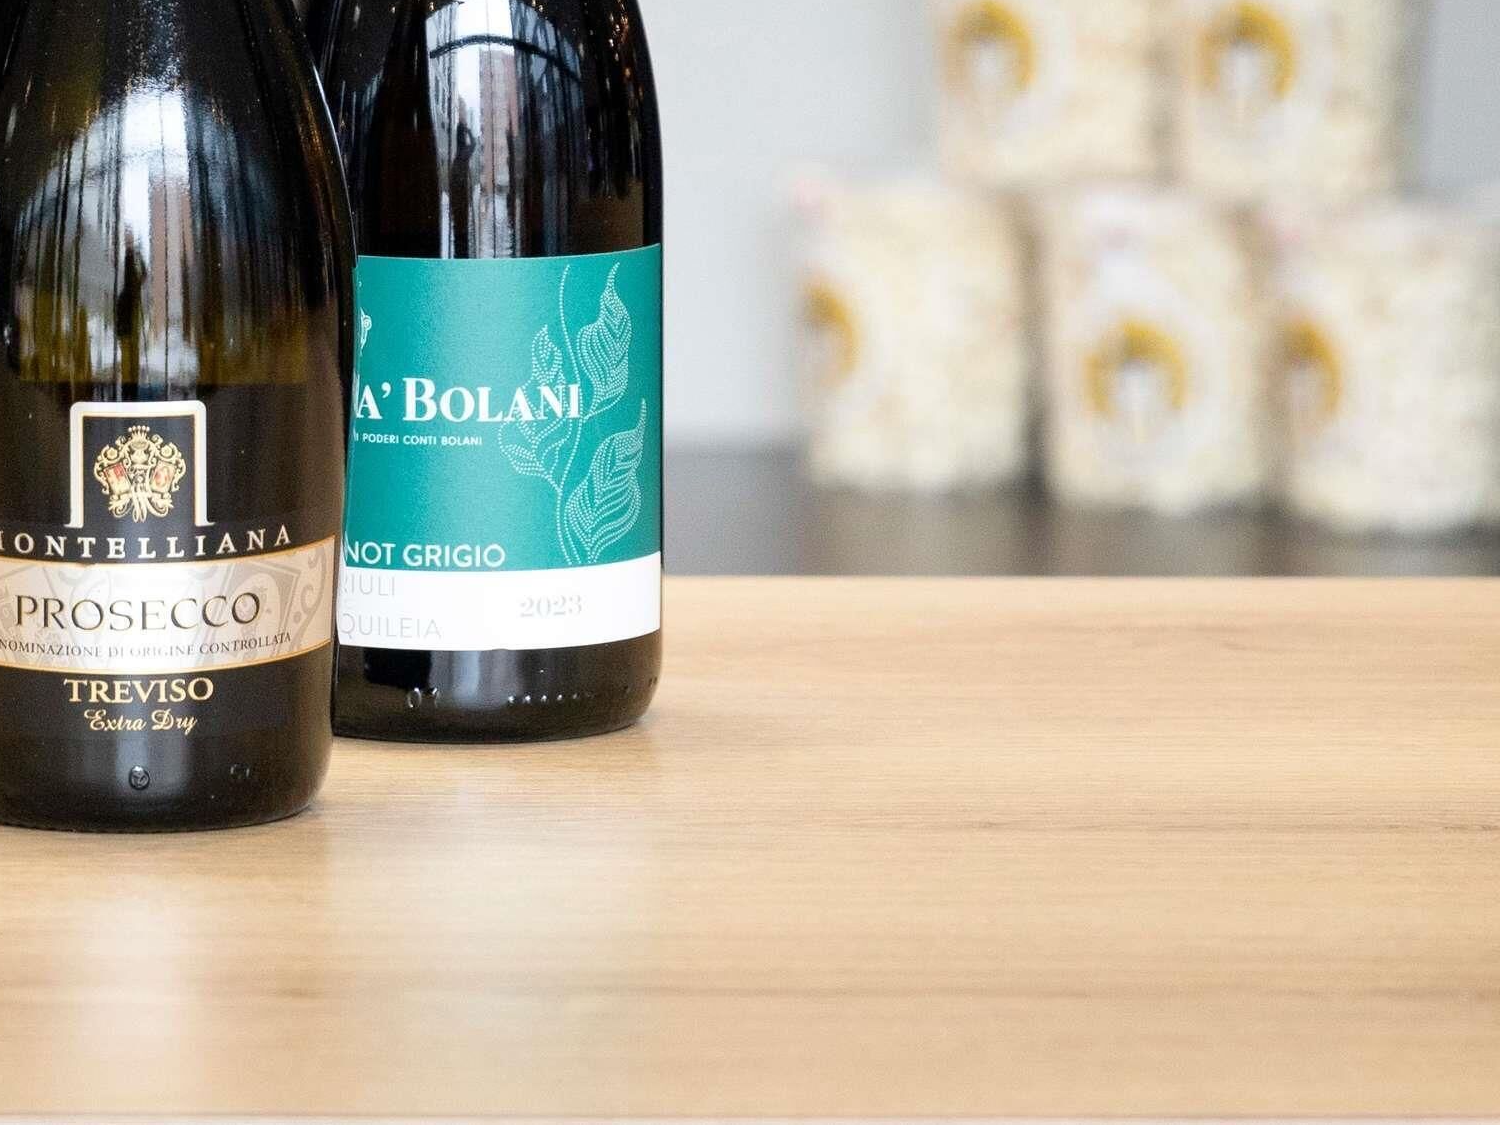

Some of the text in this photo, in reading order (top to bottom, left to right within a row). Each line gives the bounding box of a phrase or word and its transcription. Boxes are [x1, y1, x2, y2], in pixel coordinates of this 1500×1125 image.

[354, 375, 581, 423] A' BOLANI
[362, 433, 400, 444] PODERI
[403, 435, 437, 445] CONTI
[441, 435, 483, 446] BOLANI
[345, 540, 506, 568] NOT GRIGIO
[15, 592, 260, 632] PROSECCO
[519, 594, 583, 618] 2023
[340, 612, 443, 640] QUILEIA
[108, 647, 124, 658] DI
[130, 644, 196, 658] ORIGINE
[199, 632, 292, 655] CONTROLLATA
[63, 677, 214, 704] TREVISO
[84, 708, 198, 736] Extra Dry
